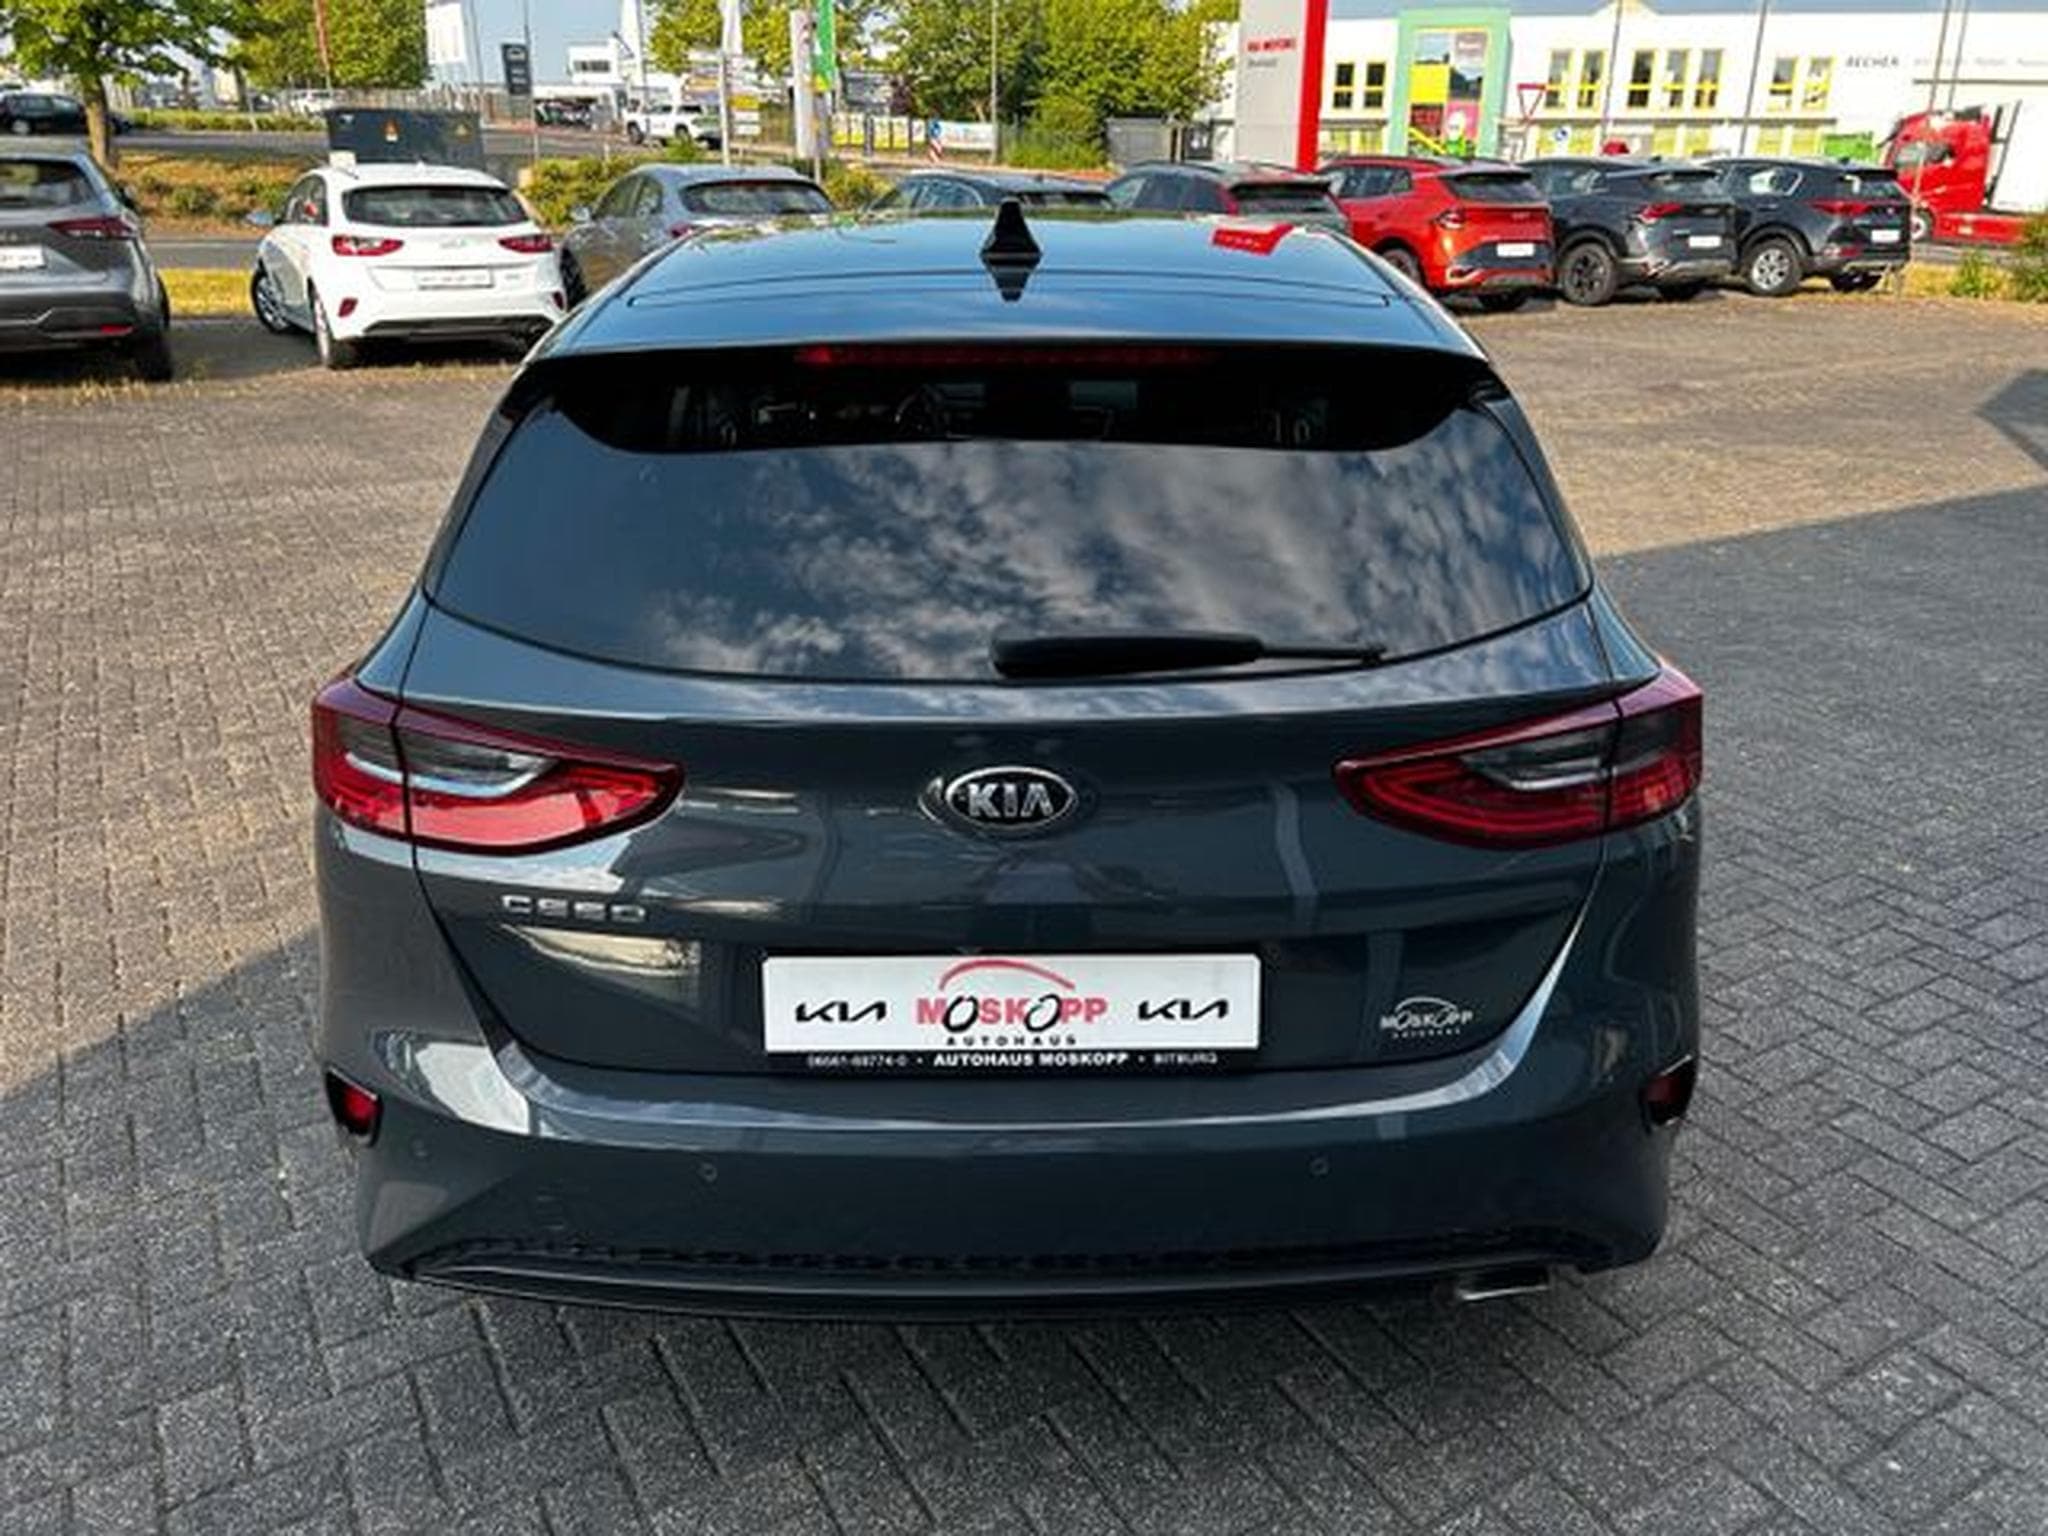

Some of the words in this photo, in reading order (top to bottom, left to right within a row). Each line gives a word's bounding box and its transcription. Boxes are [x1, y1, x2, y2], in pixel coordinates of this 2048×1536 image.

[967, 782, 1054, 818] KIA
[795, 1001, 887, 1023] KIA
[916, 994, 1108, 1034] MOSKOPP
[1138, 999, 1229, 1021] KIA
[946, 1035, 1077, 1047] AUTOHAUS
[933, 1052, 1034, 1067] AUTOHAUS
[1039, 1052, 1130, 1067] MOSKOPP
[1153, 1052, 1218, 1065] BITBURG
